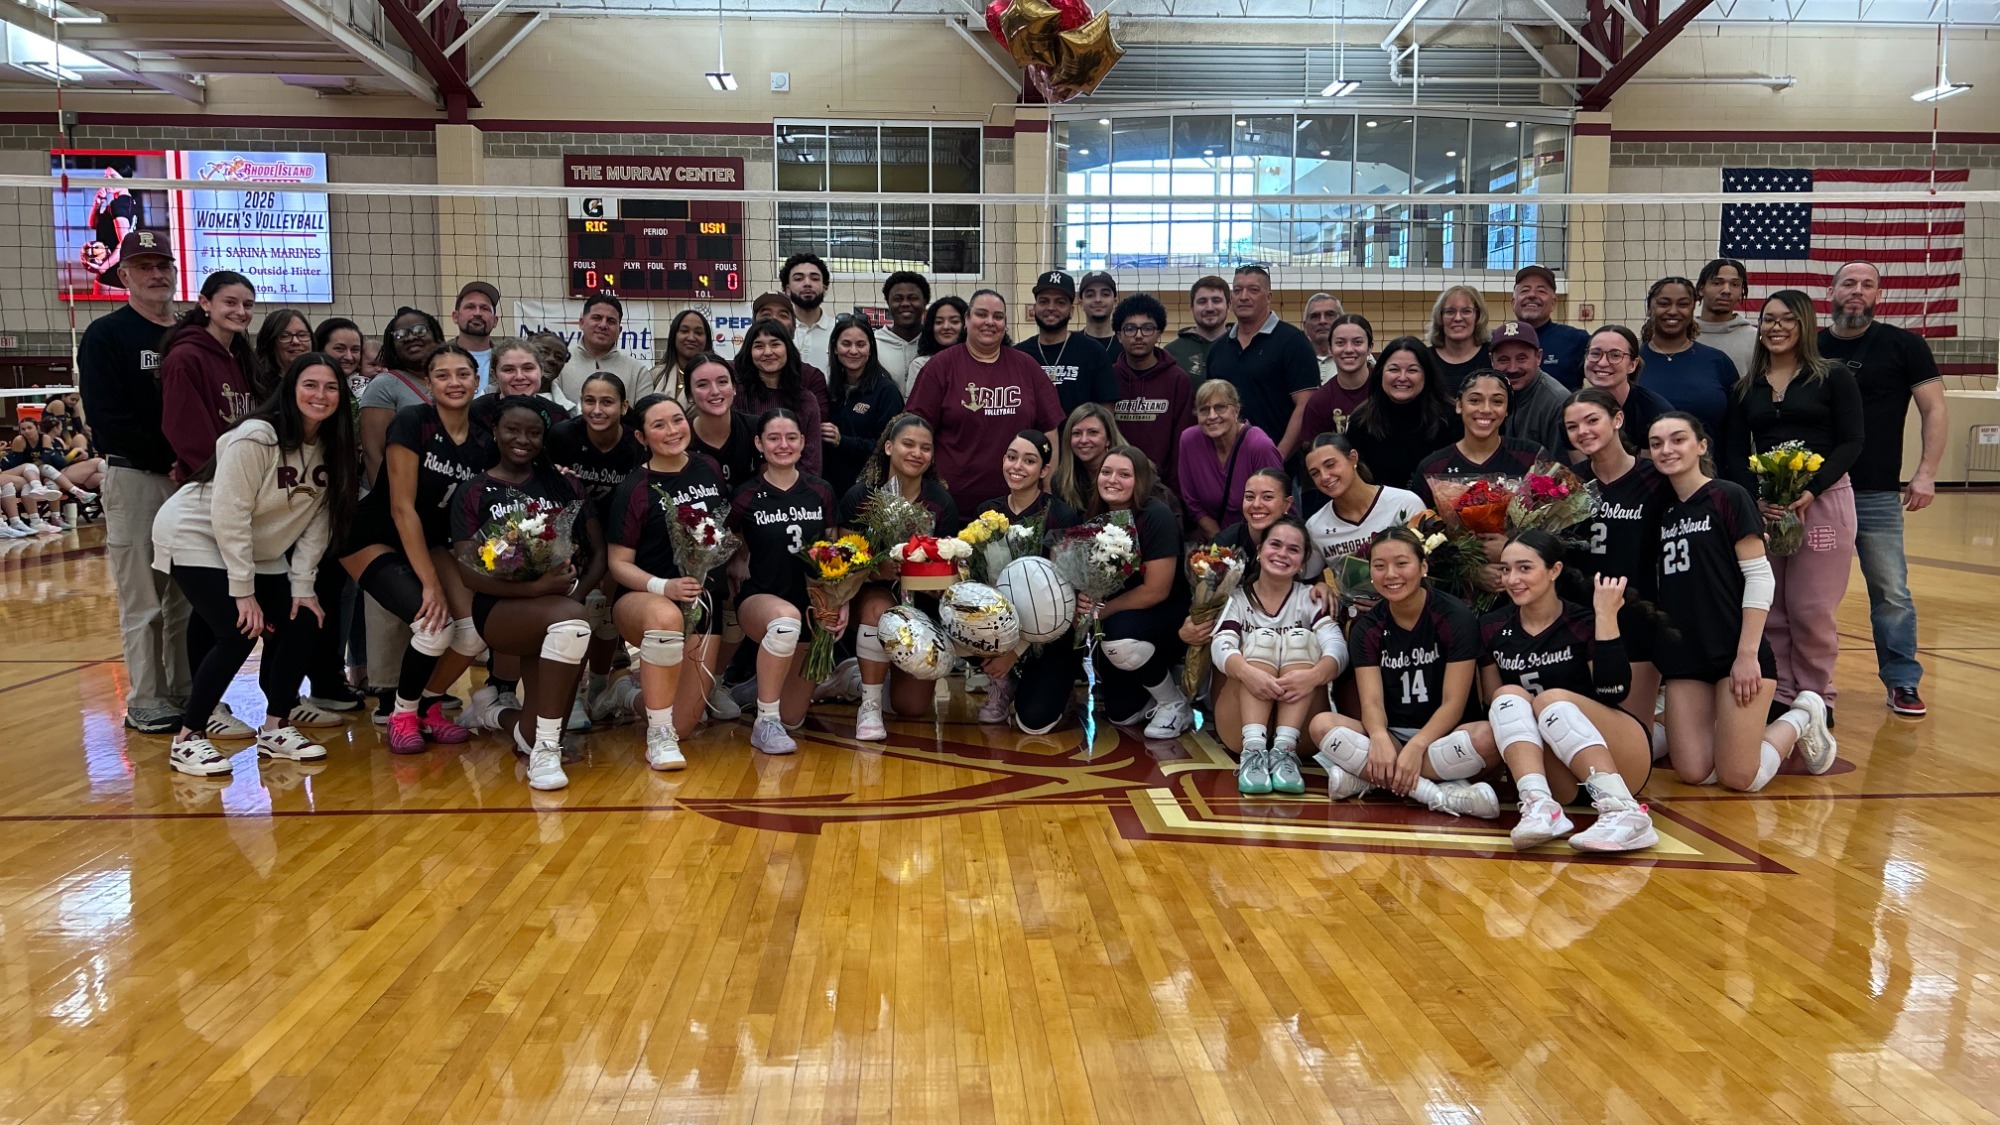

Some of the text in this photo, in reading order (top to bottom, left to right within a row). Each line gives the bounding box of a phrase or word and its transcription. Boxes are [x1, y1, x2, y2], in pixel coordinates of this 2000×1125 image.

[571, 166, 735, 182] THE MURRAY CENTER
[244, 191, 275, 208] 2026
[197, 210, 324, 229] WOMEN'S VOLLEYBALL
[585, 221, 608, 232] RIC
[700, 222, 726, 234] USM
[201, 246, 320, 258] #11 SARINA MARINES
[202, 266, 321, 276] Sei Outside Hitter
[586, 270, 597, 288] 0
[604, 274, 614, 285] 4
[1049, 272, 1062, 284] NY
[254, 284, 298, 294] ton, R.I.
[698, 275, 708, 286] 4
[727, 272, 738, 290] 0
[716, 317, 752, 328] PEP
[979, 386, 1021, 408] RIC
[424, 451, 484, 480] Rhode Isla
[572, 462, 632, 484] Rhode Islan
[659, 490, 691, 510] Rode
[754, 506, 823, 525] Rhode Island
[1600, 502, 1643, 520] Island
[1678, 514, 1712, 536] Island
[786, 524, 802, 554] 3
[1590, 522, 1607, 554] 2
[1323, 537, 1371, 558] ANCHOR
[1663, 538, 1690, 575] 23
[1400, 669, 1429, 704] 14
[1520, 671, 1544, 697] 5
